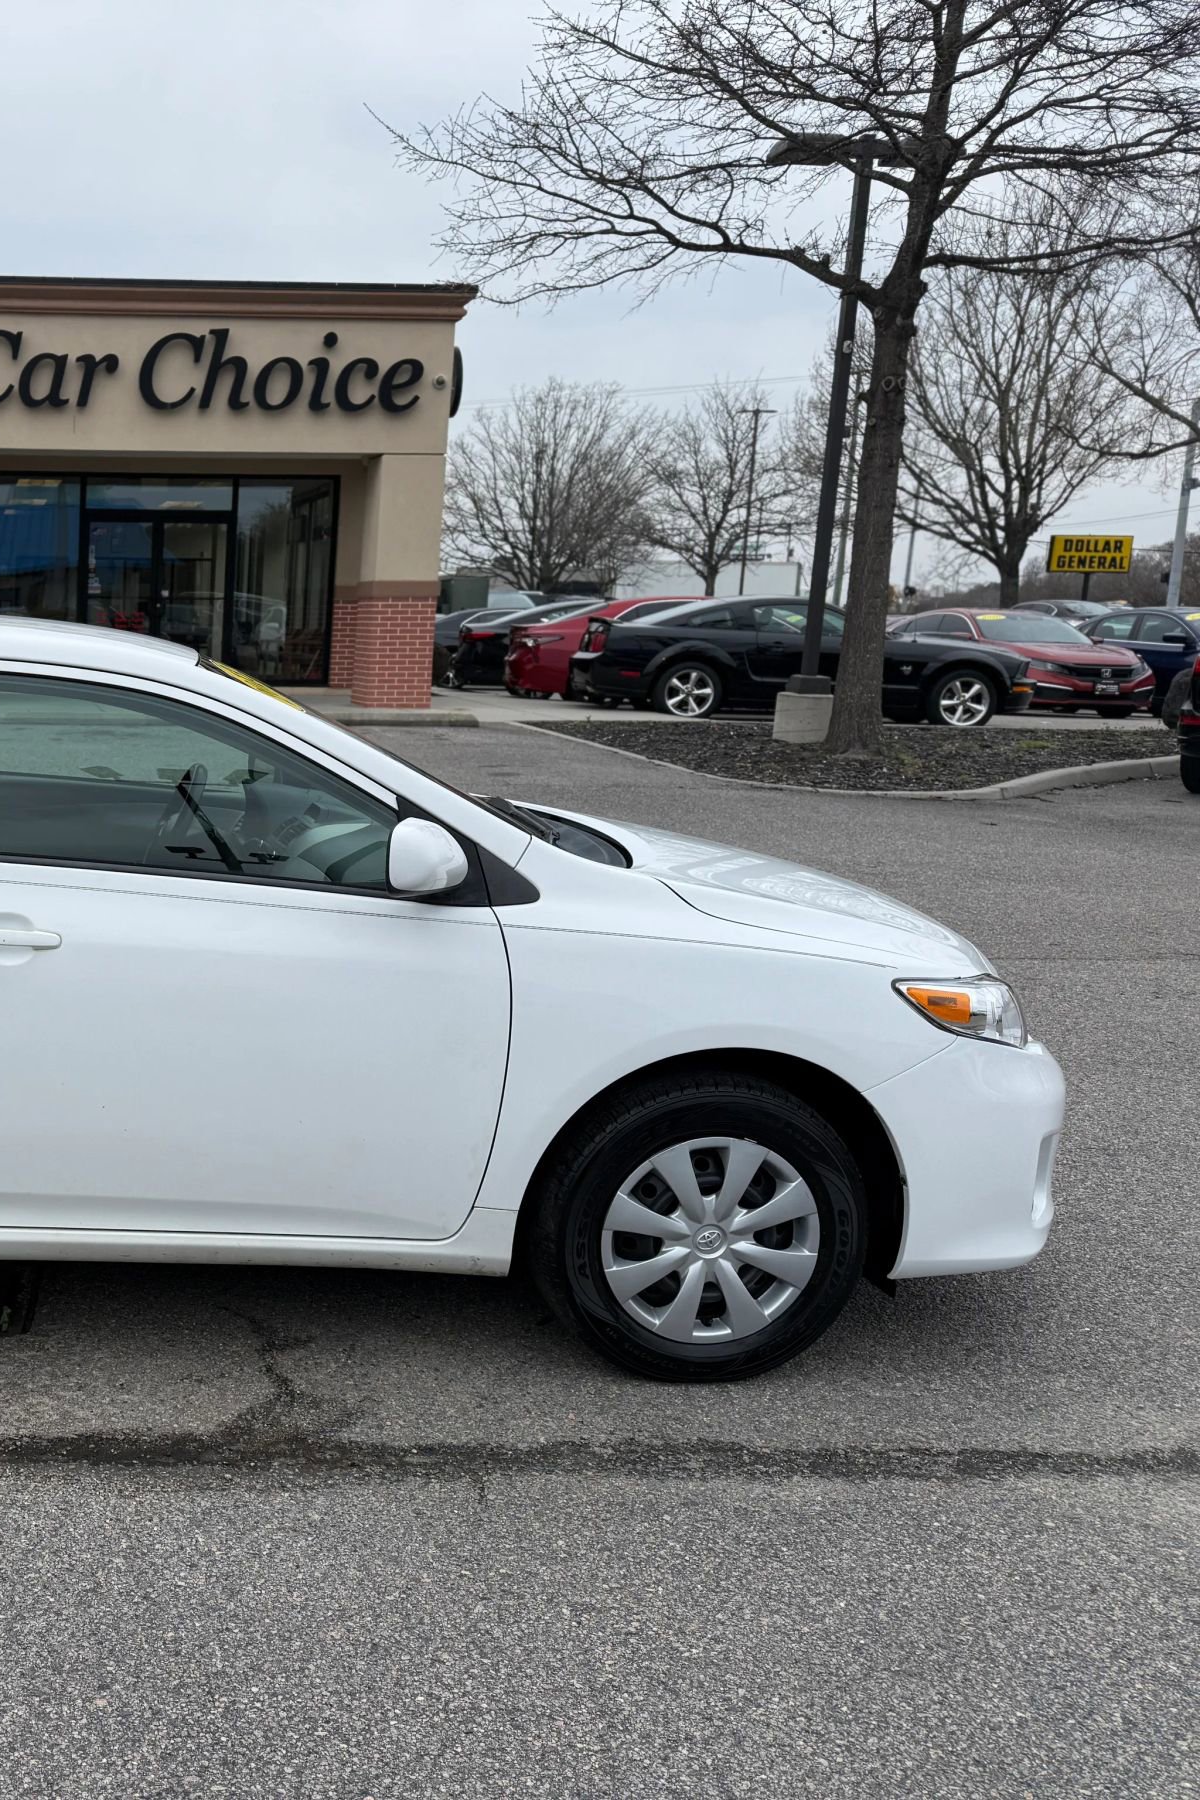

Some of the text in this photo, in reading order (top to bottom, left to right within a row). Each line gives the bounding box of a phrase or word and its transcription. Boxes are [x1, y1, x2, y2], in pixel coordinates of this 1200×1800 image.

[138, 328, 425, 412] Choice
[1063, 538, 1124, 554] DOLLAR
[1056, 554, 1126, 570] GENERAL
